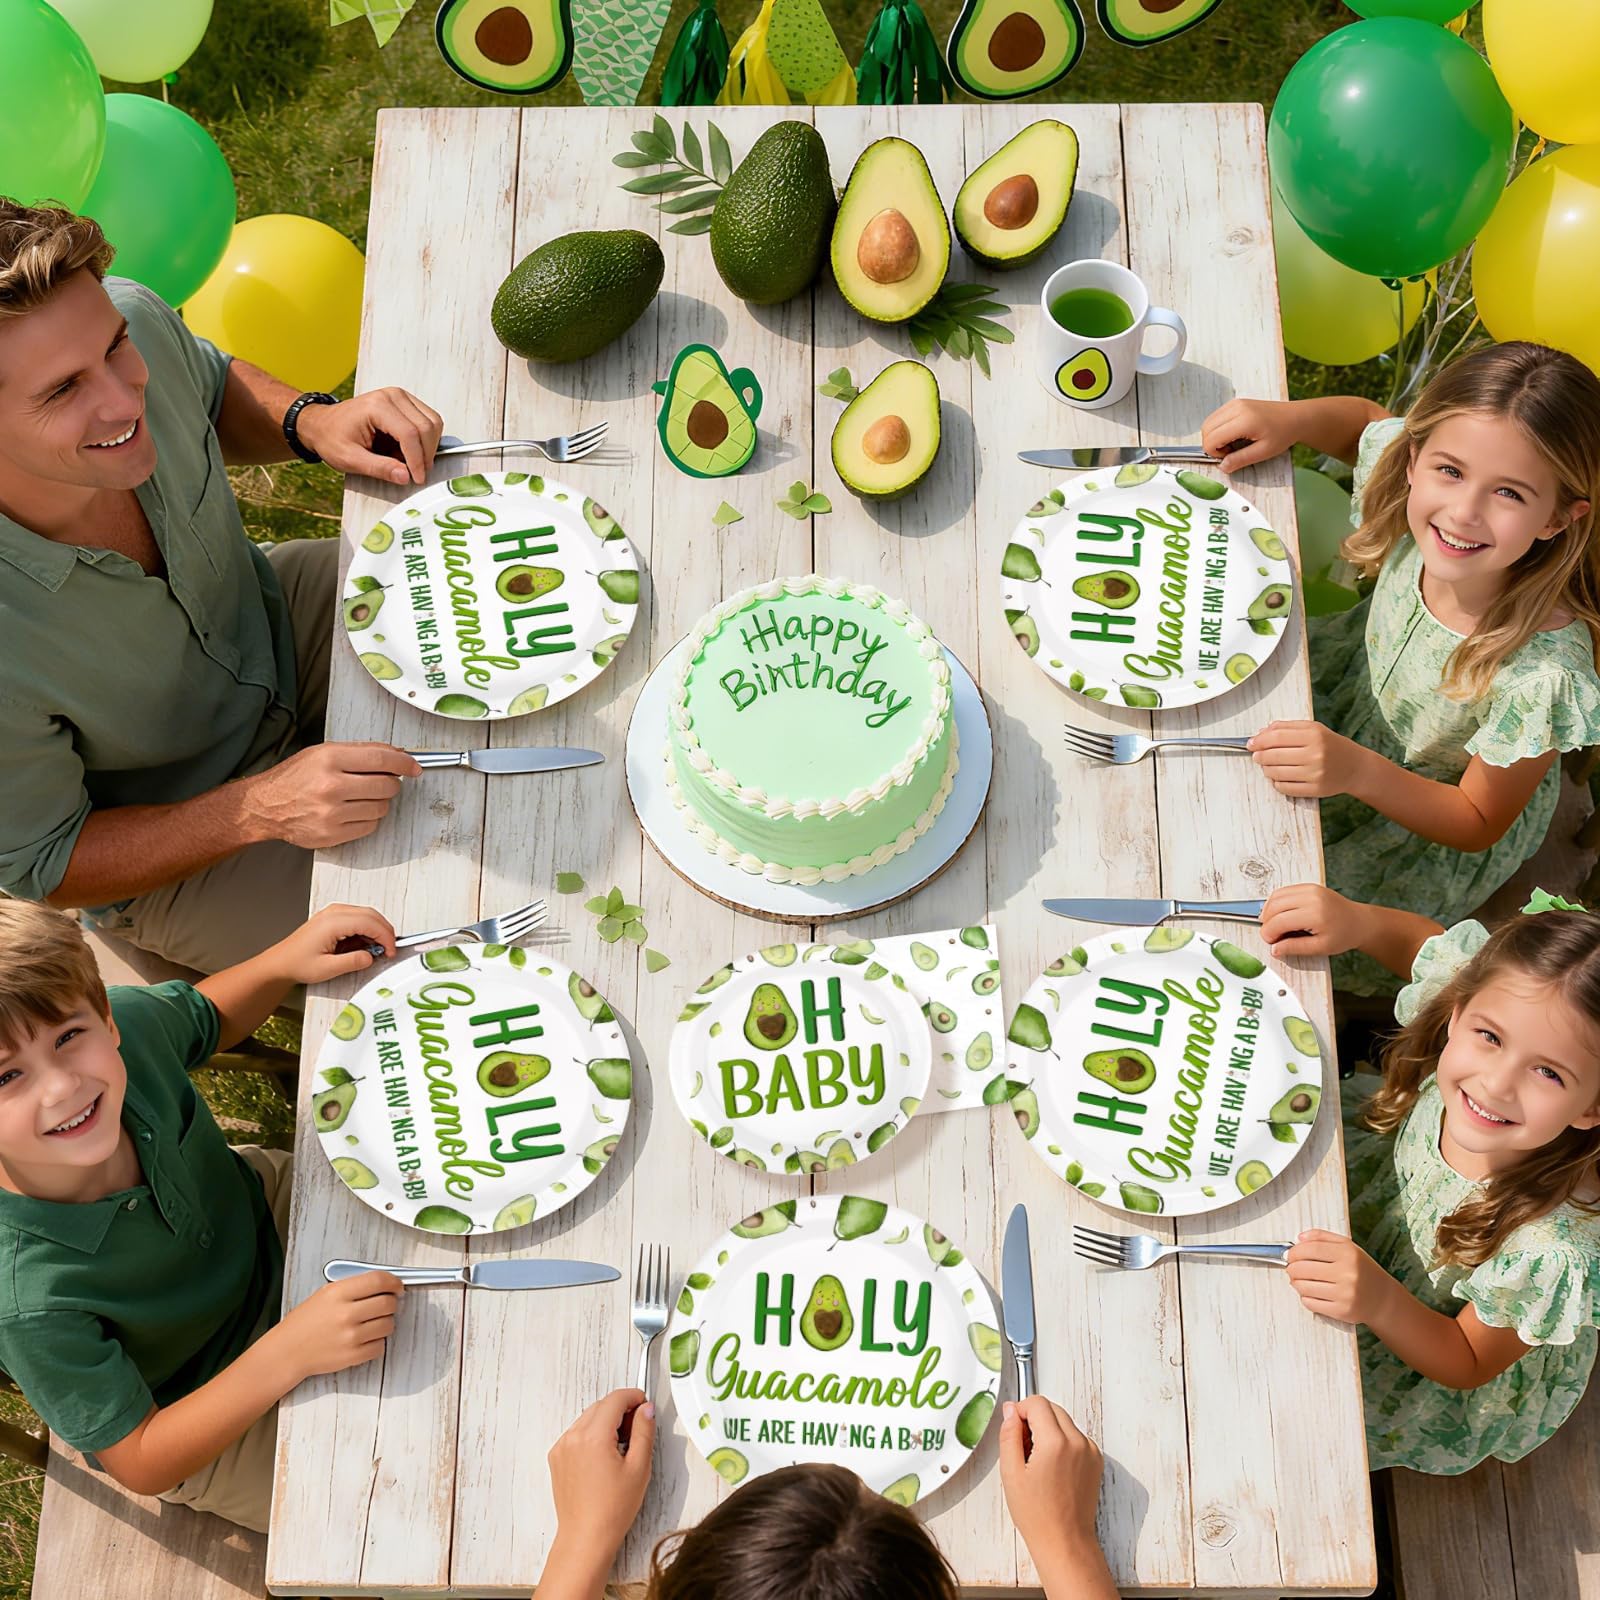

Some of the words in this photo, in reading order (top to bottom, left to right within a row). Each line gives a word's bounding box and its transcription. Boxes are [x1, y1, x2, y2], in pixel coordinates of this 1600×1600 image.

[402, 527, 423, 550] WE
[1207, 546, 1227, 556] A
[404, 554, 429, 582] ARE
[1070, 513, 1145, 643] HOLY
[1123, 495, 1192, 681] Guacamole
[434, 506, 520, 690] Guacamole
[490, 526, 576, 658] HOLY
[419, 643, 440, 654] A
[740, 609, 889, 664] Happy
[1201, 618, 1222, 646] ARE
[1198, 650, 1219, 670] WE
[720, 652, 912, 728] Birthday
[373, 1008, 397, 1036] WE
[1234, 1034, 1257, 1045] A
[376, 1040, 403, 1074] ARE
[1073, 977, 1170, 1136] HOLY
[1128, 967, 1224, 1183] Guacamole
[407, 982, 505, 1201] Guacamole
[469, 1004, 565, 1163] HOLY
[717, 1043, 886, 1119] BABY
[397, 1146, 418, 1157] A
[1214, 1115, 1241, 1149] ARE
[1208, 1151, 1233, 1177] WE
[754, 1272, 932, 1356] HOLY
[706, 1332, 960, 1410] Guacamole
[723, 1418, 751, 1442] WE
[758, 1421, 796, 1444] ARE
[880, 1427, 893, 1449] A
